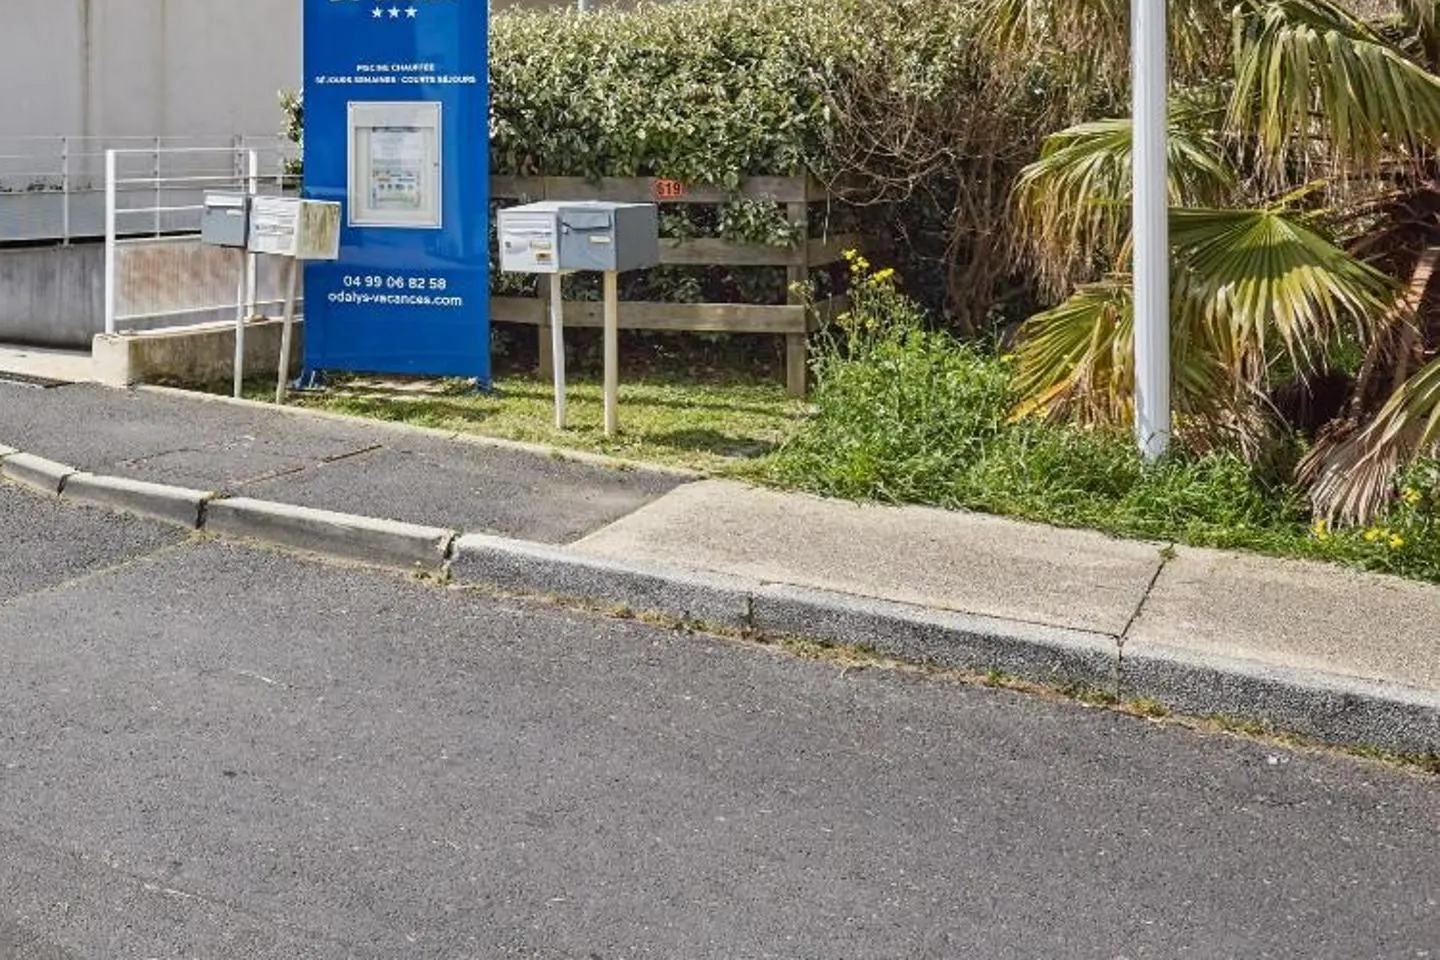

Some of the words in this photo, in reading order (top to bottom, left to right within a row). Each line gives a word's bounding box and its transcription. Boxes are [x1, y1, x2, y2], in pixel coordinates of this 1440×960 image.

[343, 275, 362, 288] 04
[364, 275, 382, 288] 99
[386, 275, 405, 289] 06
[408, 277, 426, 289] 82
[429, 278, 447, 290] 58
[327, 291, 463, 306] odalys-vacances.com
